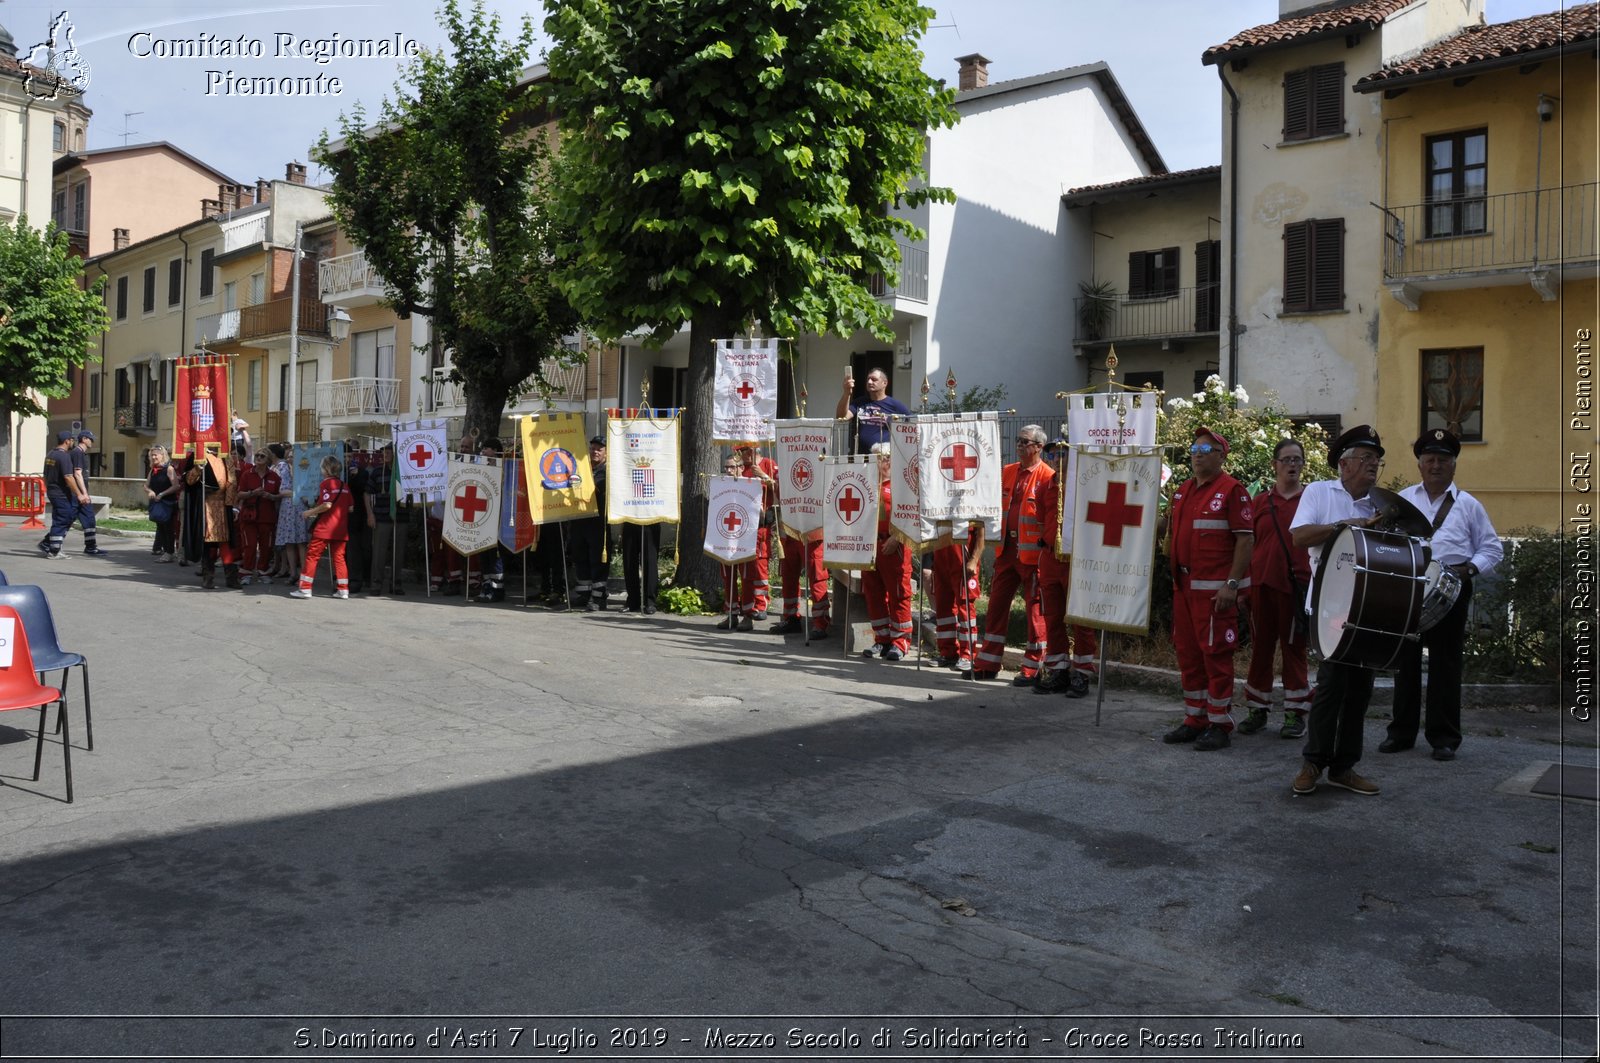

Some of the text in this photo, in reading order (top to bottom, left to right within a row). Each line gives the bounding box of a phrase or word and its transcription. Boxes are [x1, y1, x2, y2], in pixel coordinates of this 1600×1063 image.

[941, 427, 965, 438] ROSSA
[1088, 428, 1110, 437] CROCE
[780, 434, 827, 443] CROCE ROSSA
[905, 436, 919, 444] ITA
[461, 467, 480, 475] ROSSA
[1079, 462, 1101, 486] CROCE
[1105, 460, 1127, 472] RSSA
[836, 470, 855, 482] ROSSA
[855, 473, 875, 504] ITALIANA
[803, 497, 823, 506] LOCAL
[897, 503, 920, 511] MONT
[456, 527, 480, 536] COMITATO
[457, 535, 477, 543] LOCALE
[1117, 563, 1150, 577] LOCALE
[1099, 582, 1137, 597] DAMIANO
[1088, 602, 1118, 616] D'ASTI
